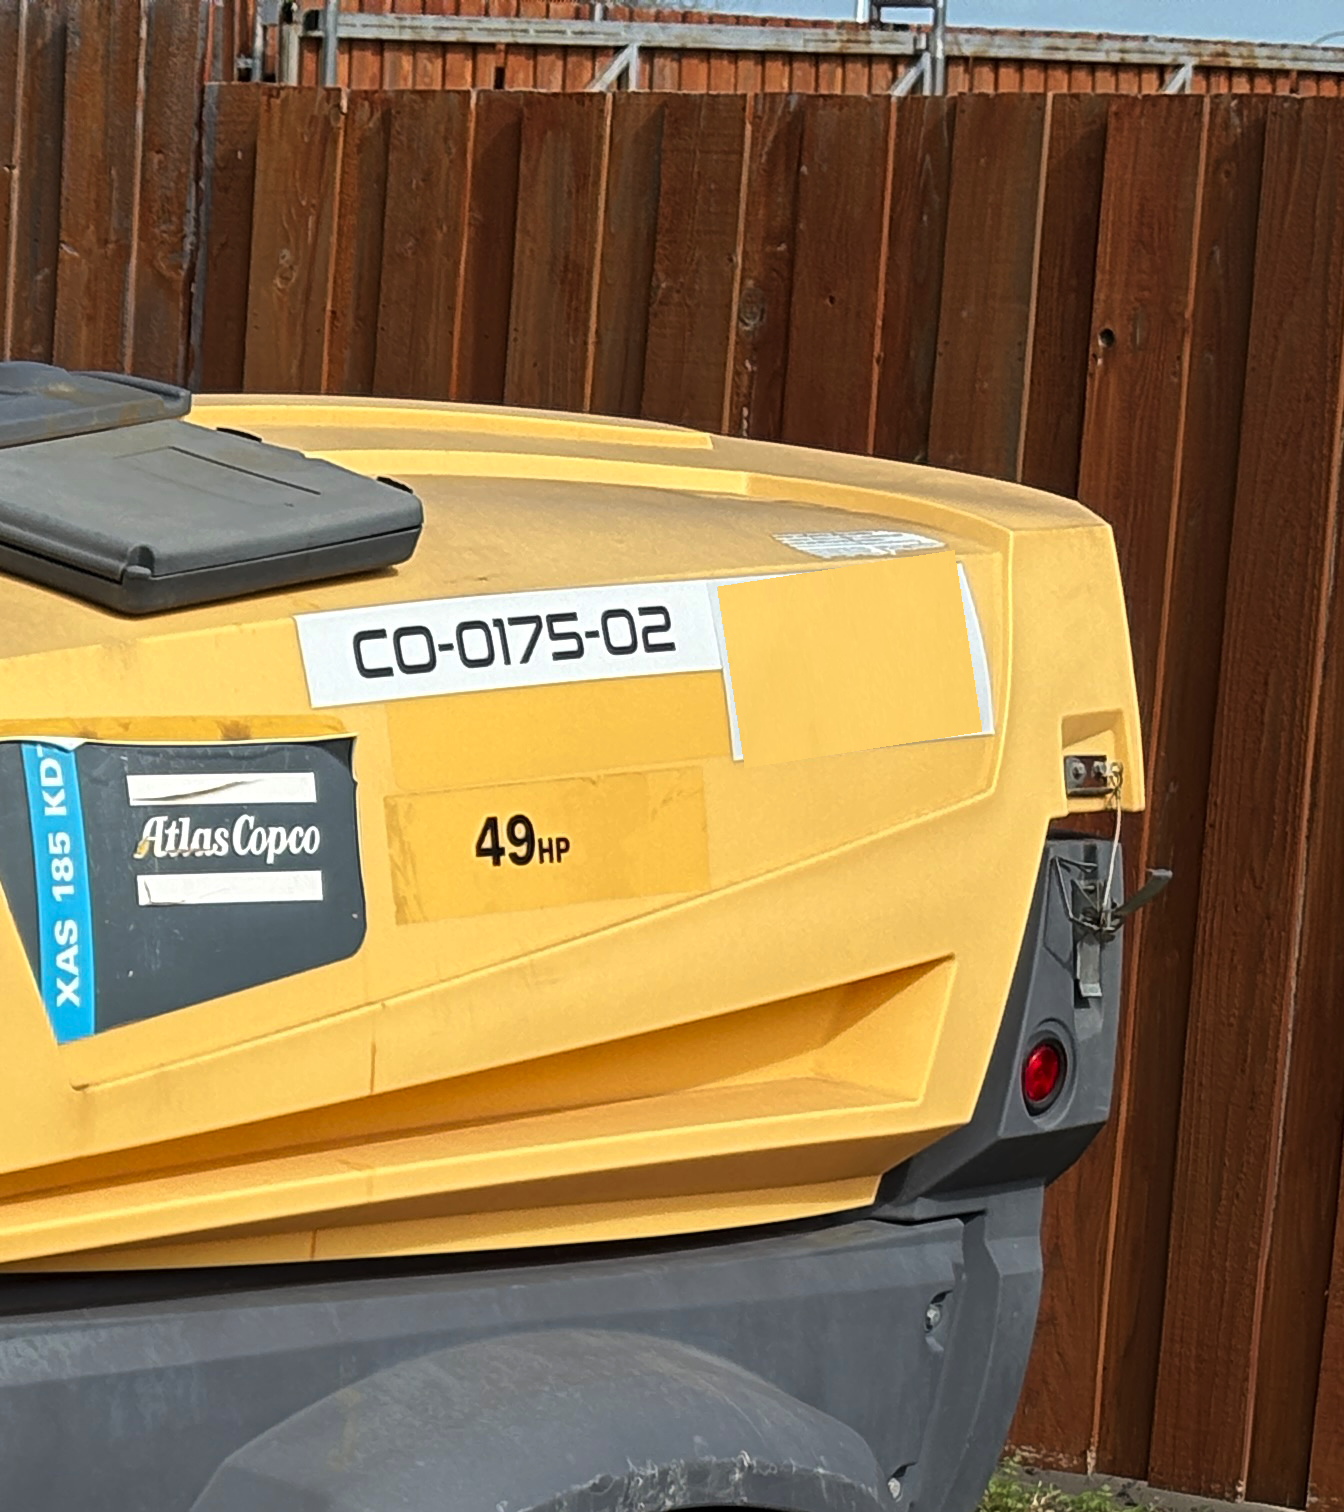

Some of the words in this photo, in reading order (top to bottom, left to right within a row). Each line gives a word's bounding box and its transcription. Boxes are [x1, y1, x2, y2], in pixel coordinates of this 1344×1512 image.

[352, 605, 676, 679] CO-0175-02
[36, 744, 68, 818] KD
[47, 831, 75, 902] 185
[133, 815, 230, 859] Atlas
[231, 814, 321, 864] Copco
[54, 918, 82, 1008] XAS
